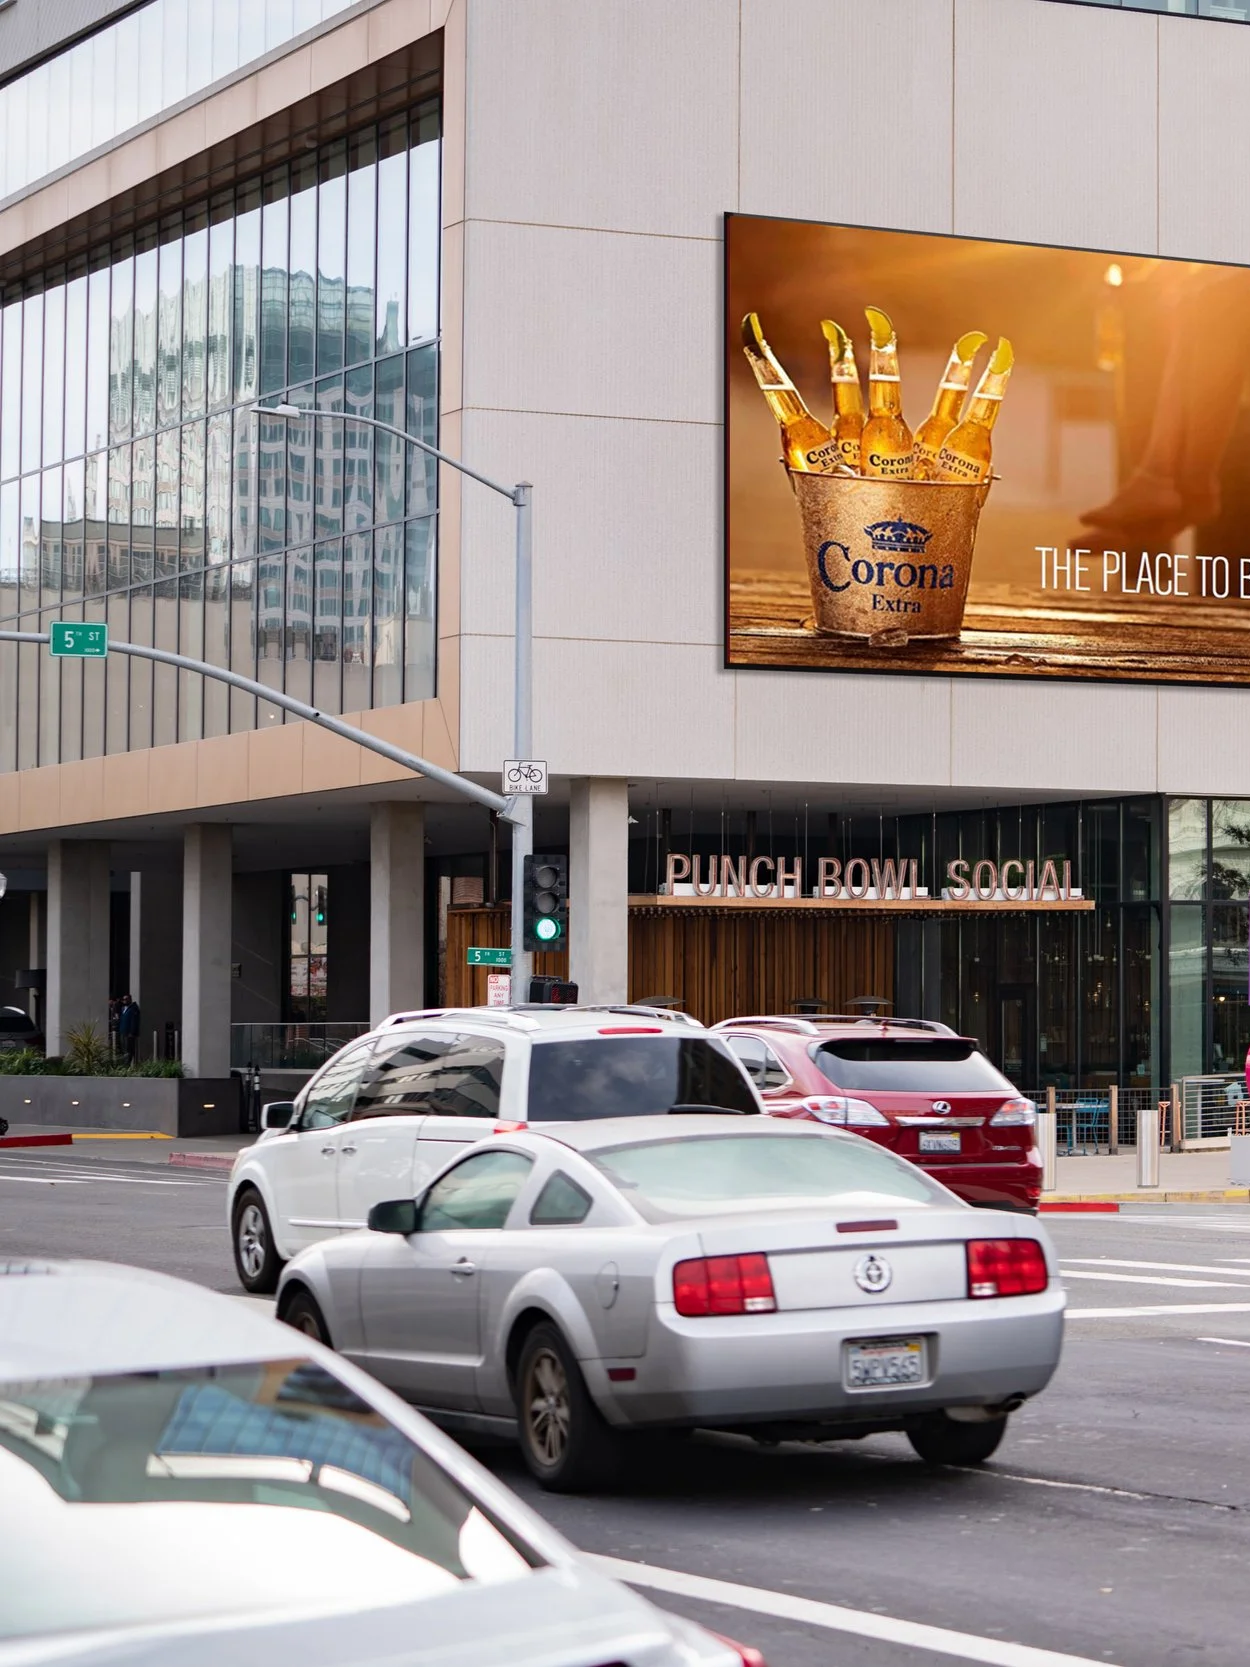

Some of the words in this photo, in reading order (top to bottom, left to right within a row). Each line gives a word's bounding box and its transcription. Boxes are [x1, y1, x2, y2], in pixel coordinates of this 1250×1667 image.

[817, 540, 954, 593] Corona
[1035, 546, 1091, 592] THE
[1103, 550, 1189, 597] PLACE
[1195, 555, 1230, 599] TO
[871, 594, 922, 613] Extra
[88, 631, 100, 641] ST
[509, 784, 522, 792] BIKE
[666, 853, 802, 898] PUNCH
[818, 856, 931, 900] BOWL
[946, 858, 1084, 901] SOCIAL
